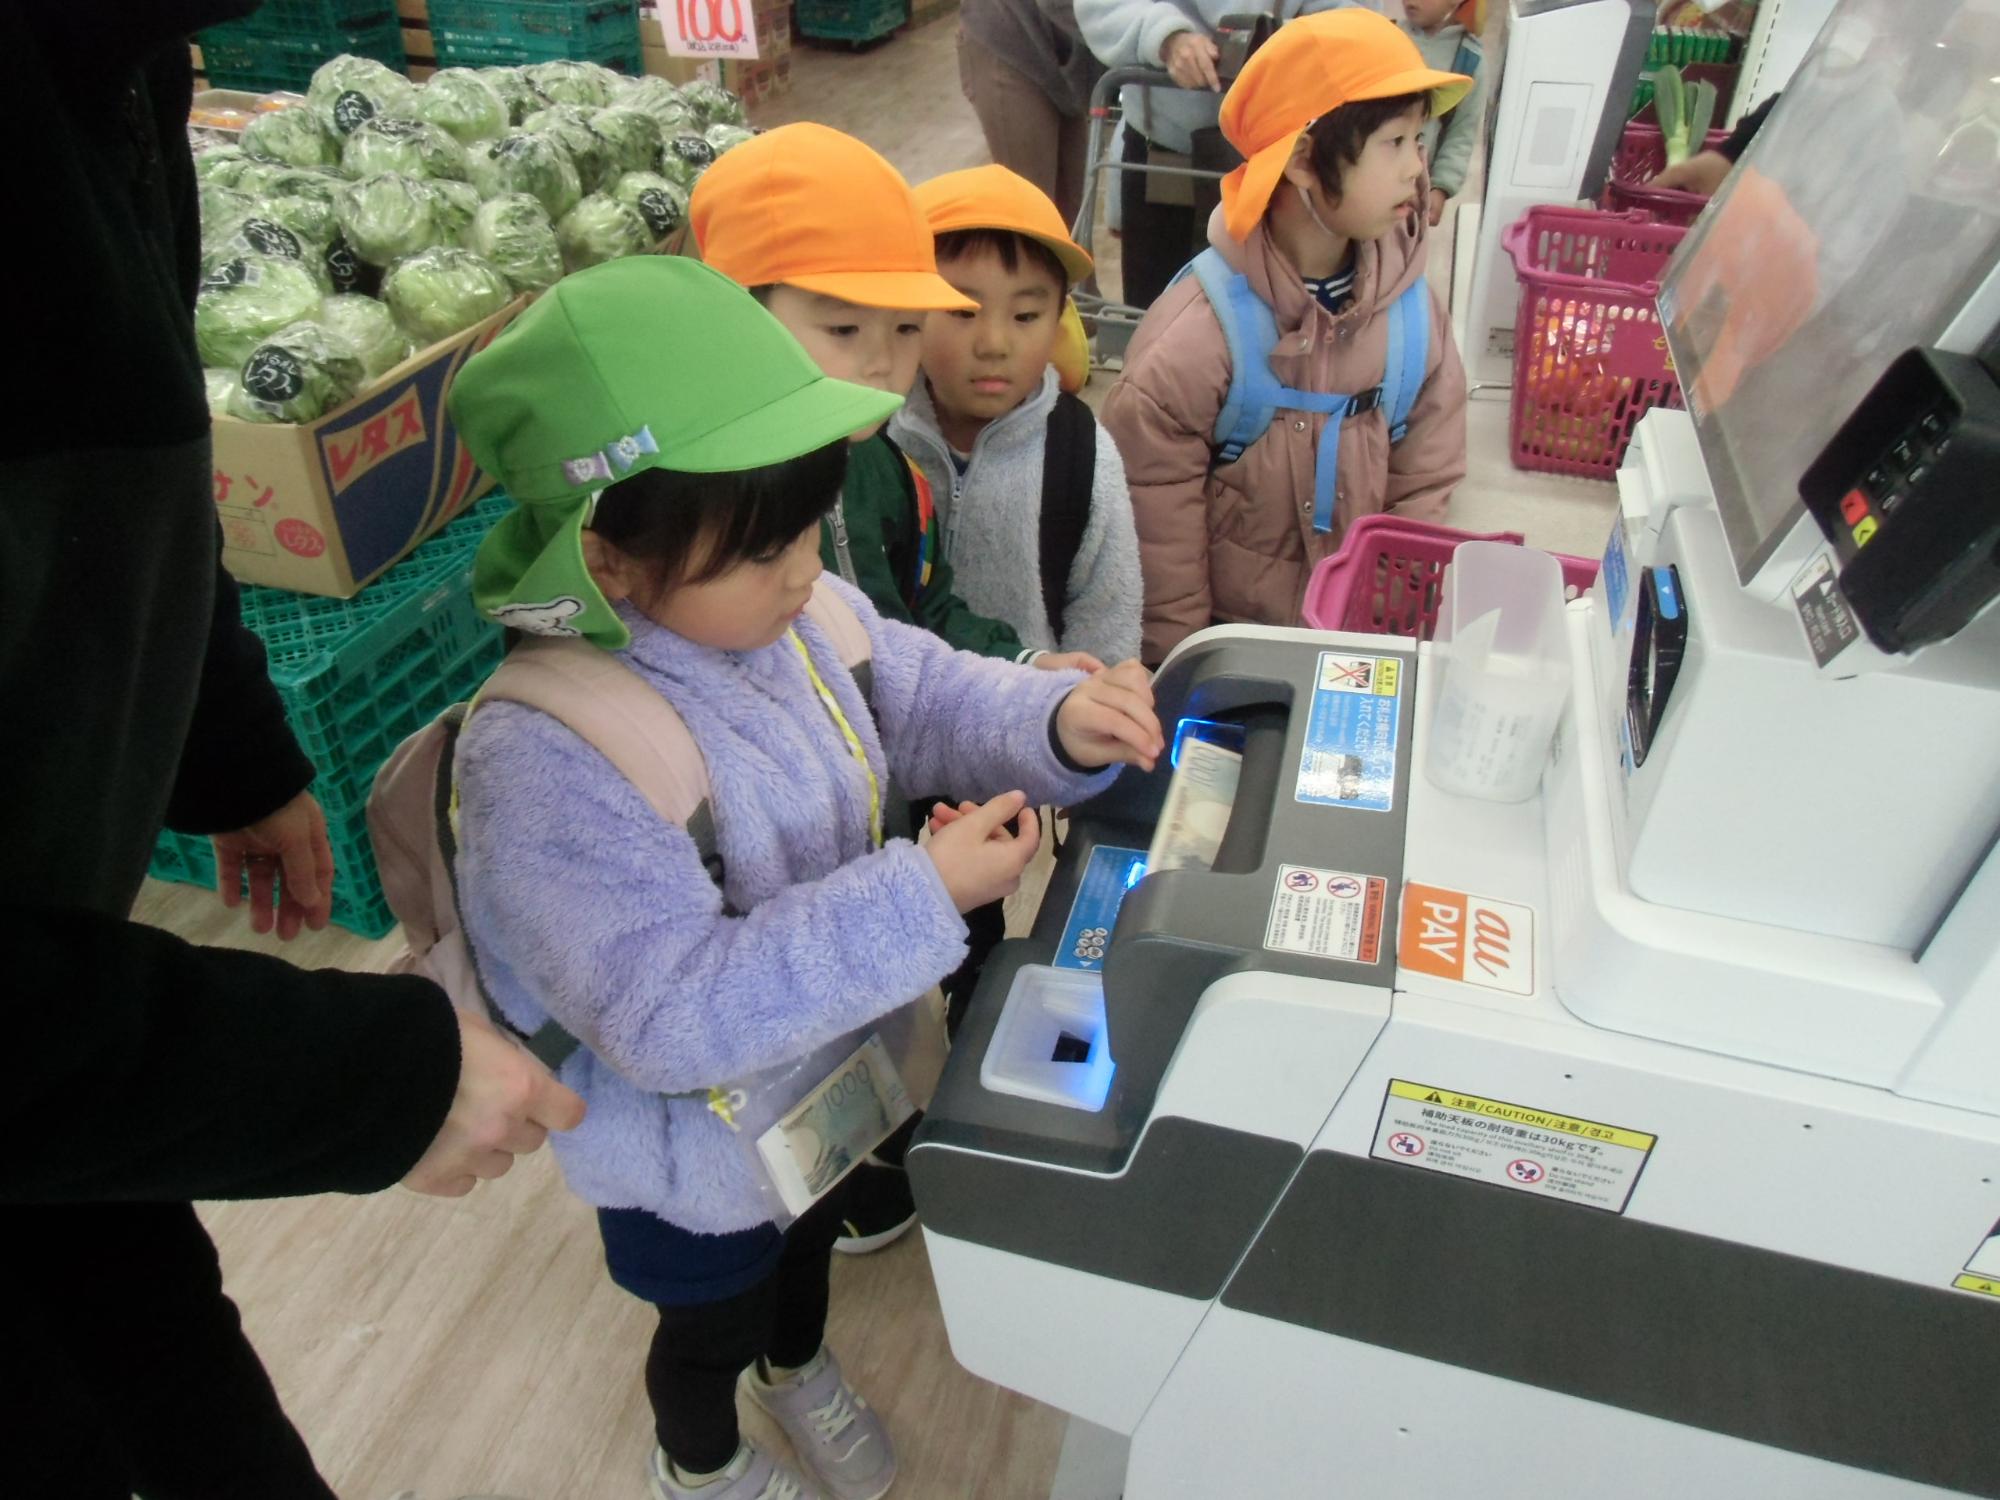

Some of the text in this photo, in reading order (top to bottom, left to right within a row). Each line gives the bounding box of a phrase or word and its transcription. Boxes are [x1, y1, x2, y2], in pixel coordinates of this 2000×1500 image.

[676, 0, 743, 42] 100
[244, 361, 293, 398] レタス
[327, 396, 423, 482] レタス
[1418, 900, 1460, 965] PAY
[1472, 907, 1511, 978] au
[822, 1060, 871, 1114] 1000
[1421, 1108, 1604, 1156] 補助天板の耐荷重は30kgです。
